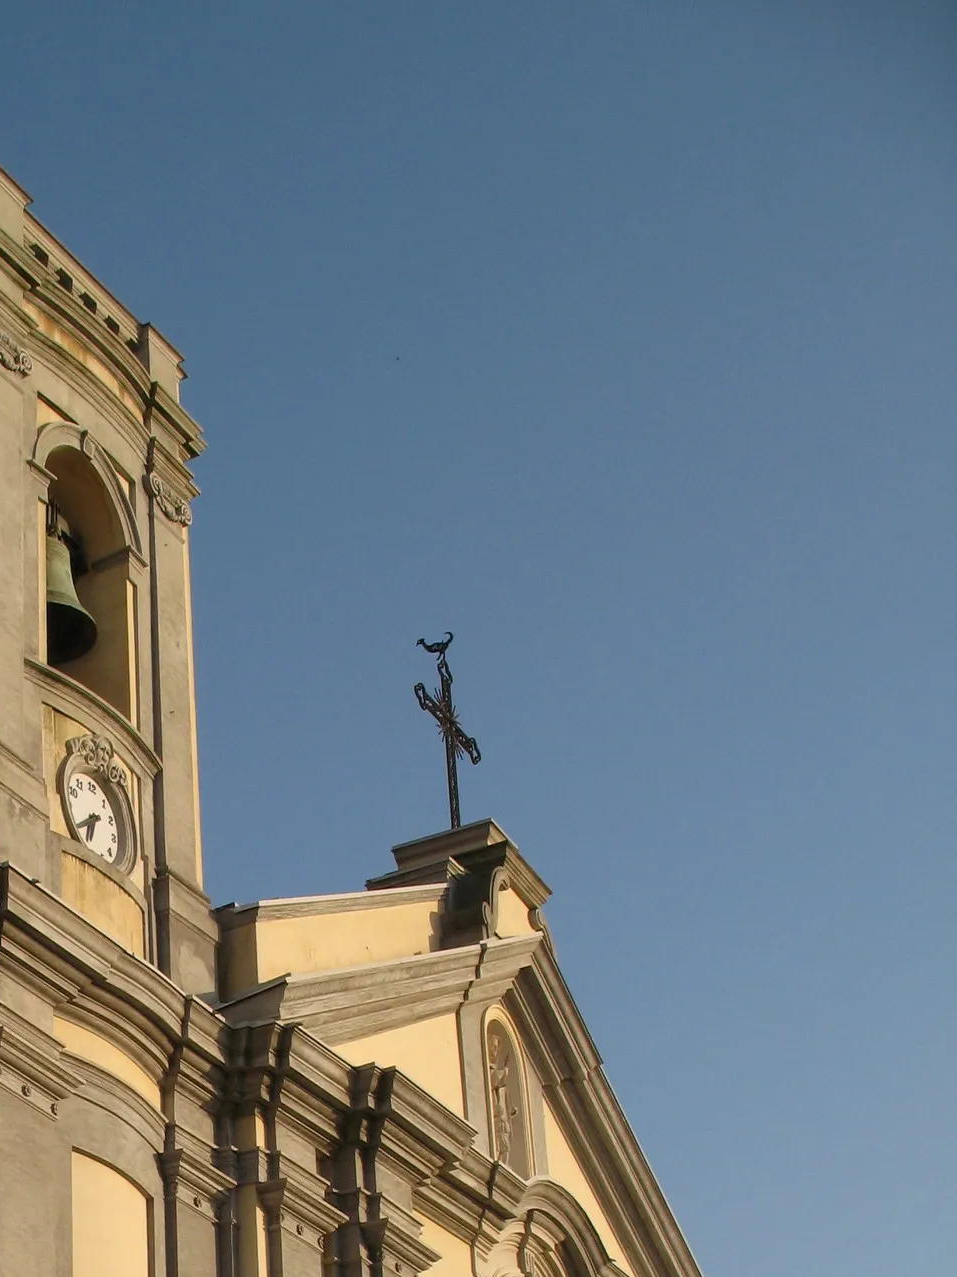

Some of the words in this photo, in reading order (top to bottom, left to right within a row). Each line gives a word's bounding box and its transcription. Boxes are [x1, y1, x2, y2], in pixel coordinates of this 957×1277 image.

[75, 778, 83, 791] 11
[87, 781, 97, 795] 12
[69, 786, 78, 799] 10
[101, 799, 106, 810] 1
[108, 815, 114, 826] 2
